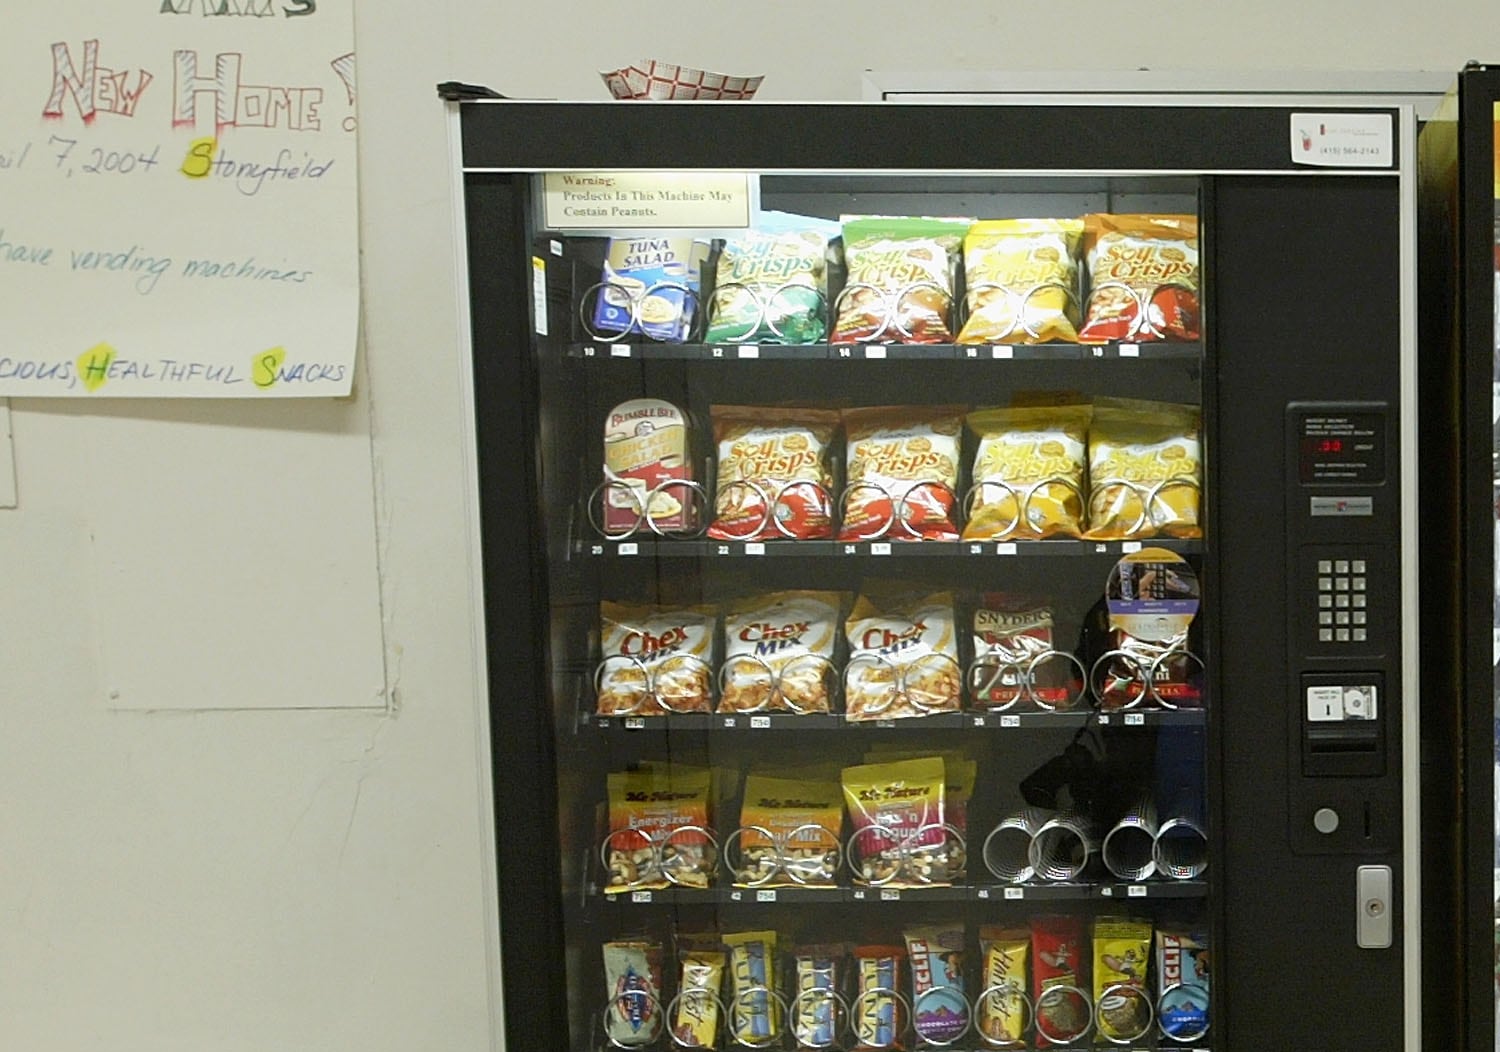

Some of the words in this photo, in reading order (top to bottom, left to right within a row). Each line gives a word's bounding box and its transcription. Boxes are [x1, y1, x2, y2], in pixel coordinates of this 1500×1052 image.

[563, 176, 616, 187] Warning:
[564, 192, 612, 202] Products
[615, 192, 630, 201] In
[632, 191, 655, 202] This
[658, 191, 705, 201] Machine
[709, 191, 733, 204] May
[564, 206, 608, 217] Contain
[611, 207, 658, 217] Peanuts.
[623, 251, 676, 267] SALAD
[628, 239, 671, 254] TUNA
[71, 245, 172, 296] vending
[182, 256, 312, 284] machines
[732, 252, 814, 281] Crisps
[1110, 256, 1194, 280] Crisps
[738, 450, 817, 476] Crisps
[621, 624, 689, 657] Chex
[739, 621, 812, 643] Chex
[629, 814, 694, 830] Energizer
[911, 939, 932, 984] CLIF
[1164, 934, 1181, 978] CLIF
[990, 945, 1015, 1022] Harvest
[861, 958, 880, 1043] LUNA
